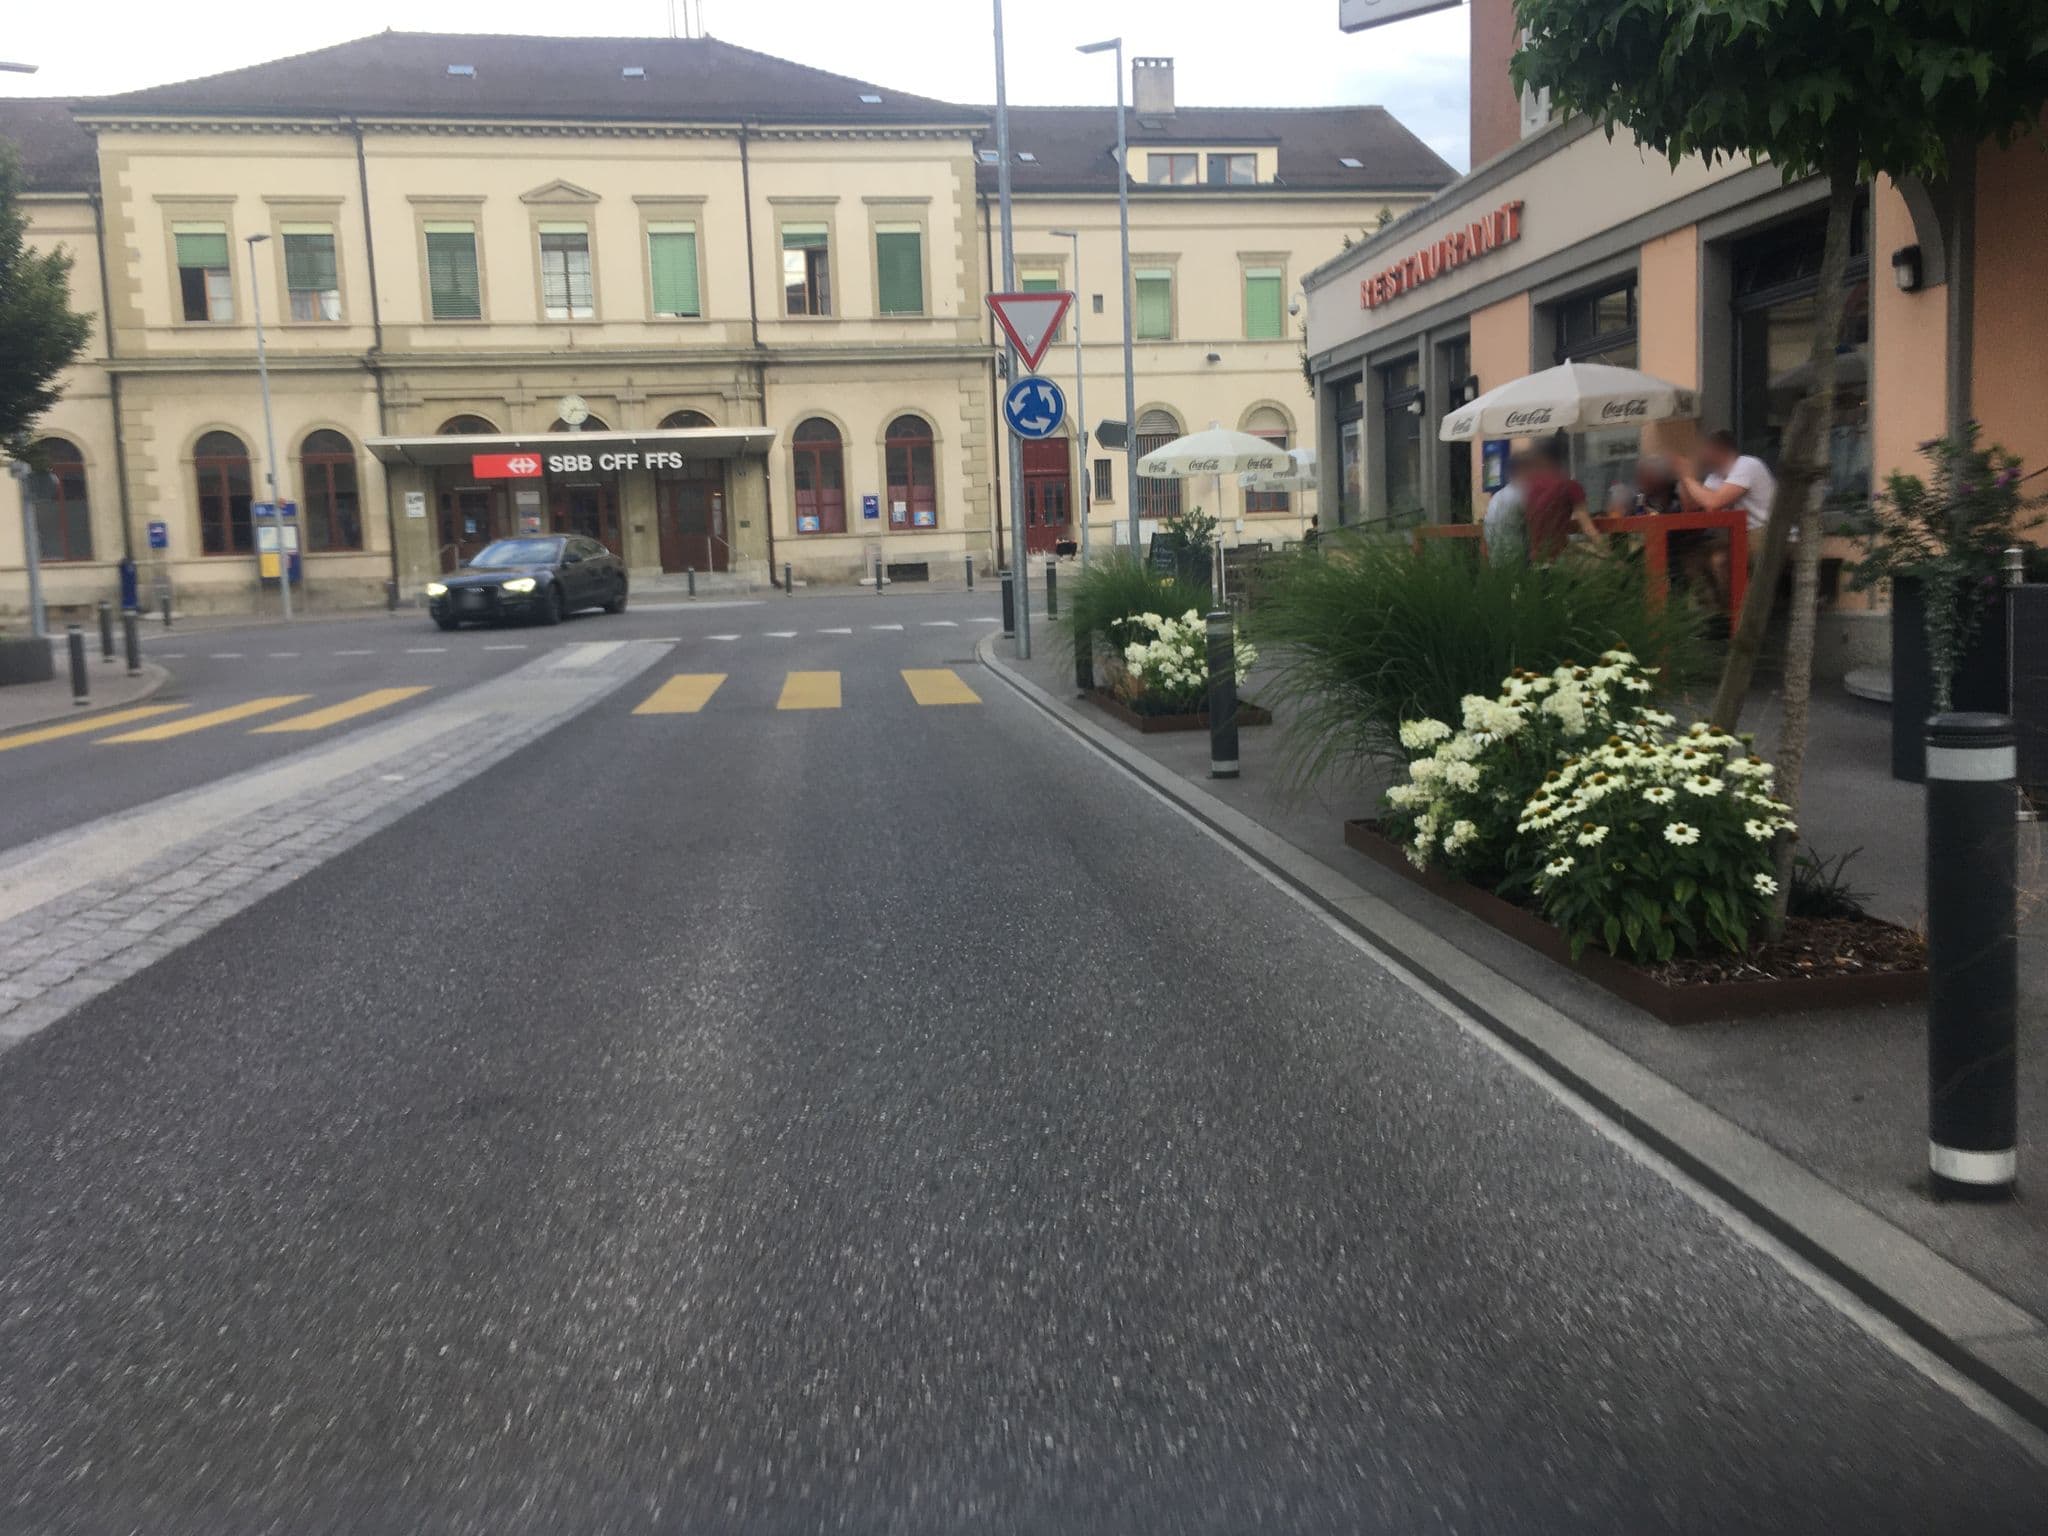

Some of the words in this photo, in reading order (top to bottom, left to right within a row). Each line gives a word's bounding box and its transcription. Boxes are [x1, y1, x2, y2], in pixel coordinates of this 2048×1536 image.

[1360, 200, 1525, 310] RESTAURANT
[549, 455, 593, 472] SBB
[600, 453, 638, 470] CFF
[645, 452, 683, 469] FFS
